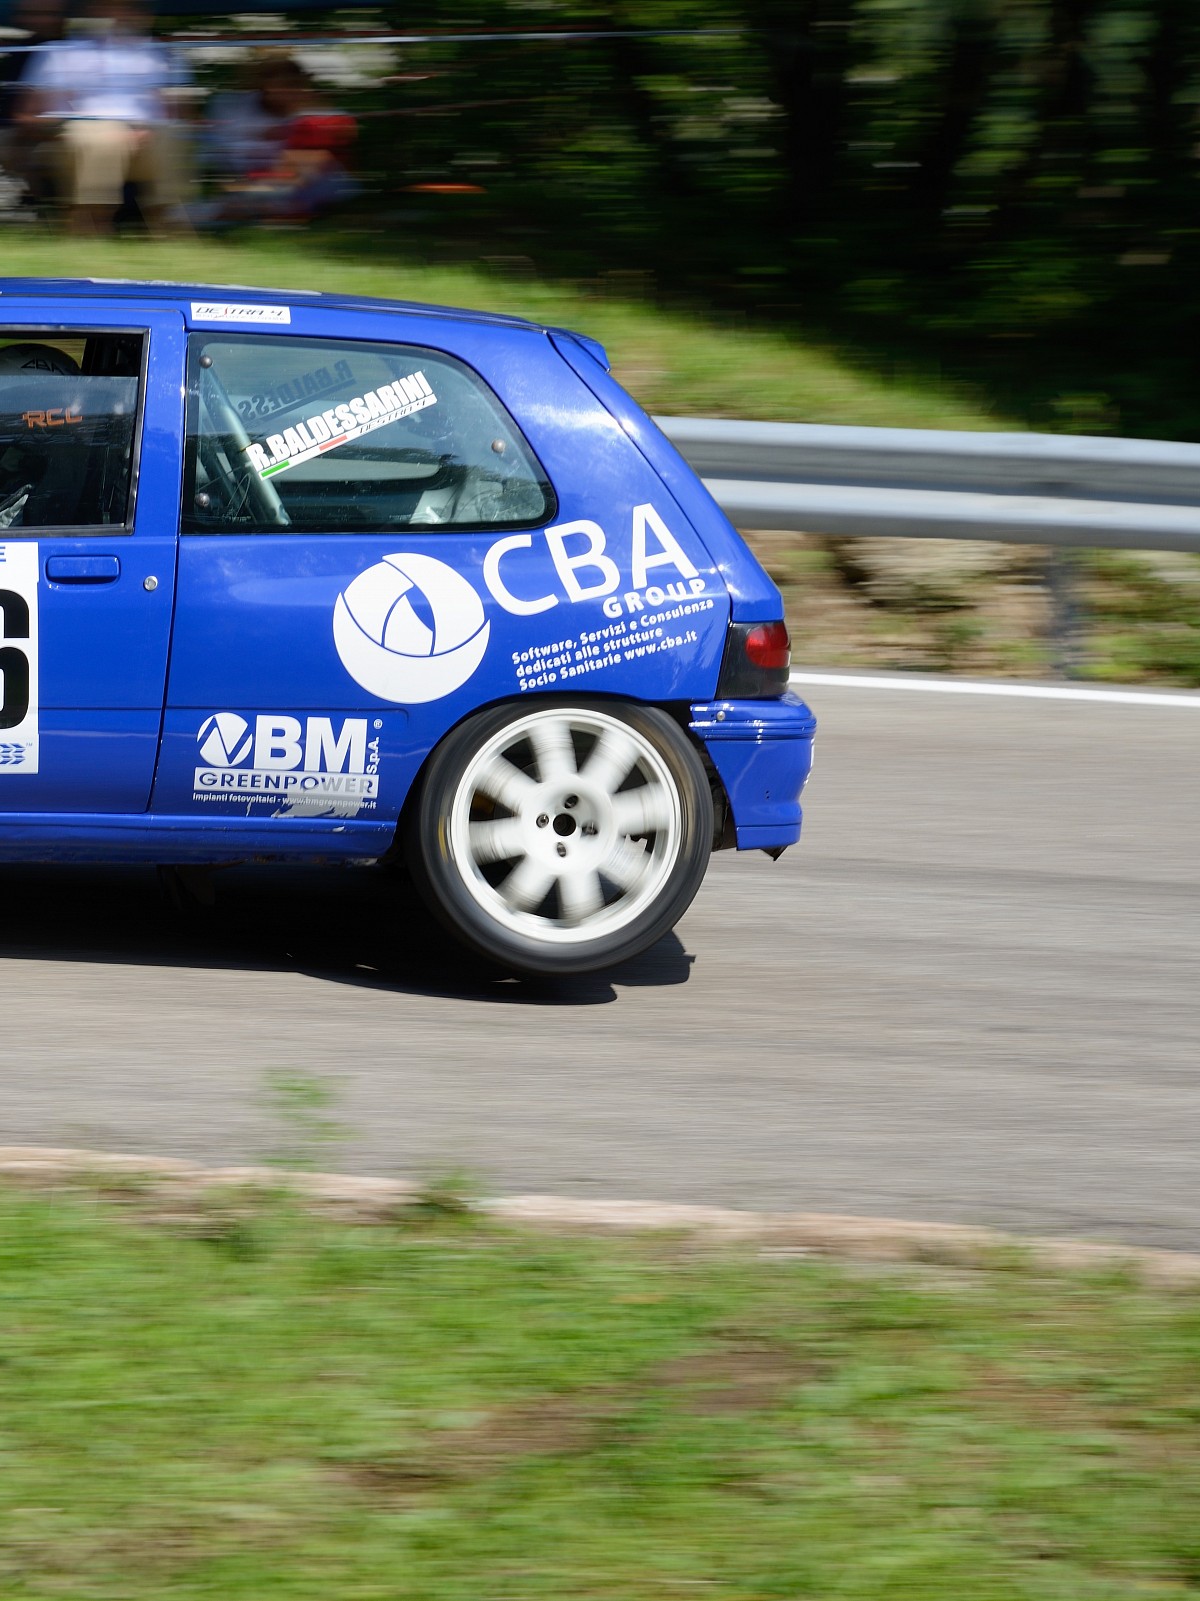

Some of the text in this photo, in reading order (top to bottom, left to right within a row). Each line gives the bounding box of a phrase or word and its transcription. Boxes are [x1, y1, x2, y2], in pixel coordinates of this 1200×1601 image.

[245, 370, 434, 471] R.BALDESSARINI
[483, 502, 699, 617] CBA
[603, 579, 706, 619] GROUP
[512, 598, 715, 665] Software, Servizi e Consulenza
[516, 626, 663, 678] dedicati alle strutture
[519, 629, 698, 692] Socio Sanitarie www.cba.it
[253, 714, 368, 774] BM
[193, 792, 228, 802] Impianti
[229, 793, 276, 803] fotovoltaici
[199, 771, 373, 794] GREENPOWER
